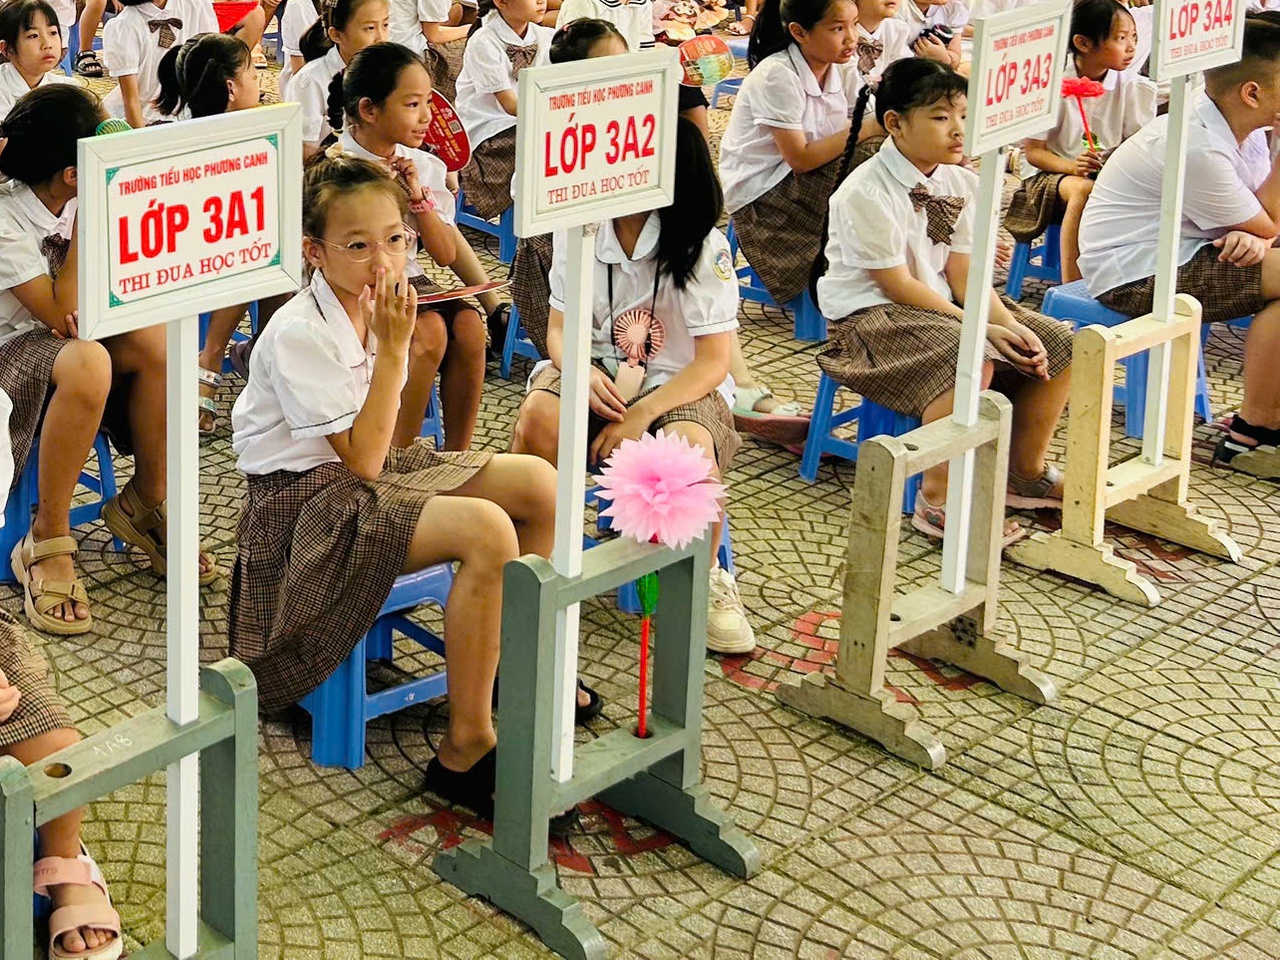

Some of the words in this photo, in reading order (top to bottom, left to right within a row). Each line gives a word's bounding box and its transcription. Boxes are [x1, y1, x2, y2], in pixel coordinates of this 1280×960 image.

[985, 52, 1018, 107] LỚP
[1020, 52, 1052, 95] 3A3
[182, 166, 202, 184] HỌC
[203, 157, 241, 177] PHƯƠNG
[243, 151, 268, 169] CANH
[544, 112, 597, 178] LỚP
[605, 113, 656, 165] 3A2
[547, 187, 570, 205] THI
[571, 182, 598, 200] ĐUA
[600, 175, 625, 196] HỌC
[628, 164, 650, 187] TỐT
[118, 198, 190, 266] LỚP
[202, 186, 265, 244] 3A1
[118, 273, 150, 295] THI
[156, 265, 194, 286] ĐUA
[199, 252, 235, 276] HỌC
[238, 237, 272, 264] TỐT
